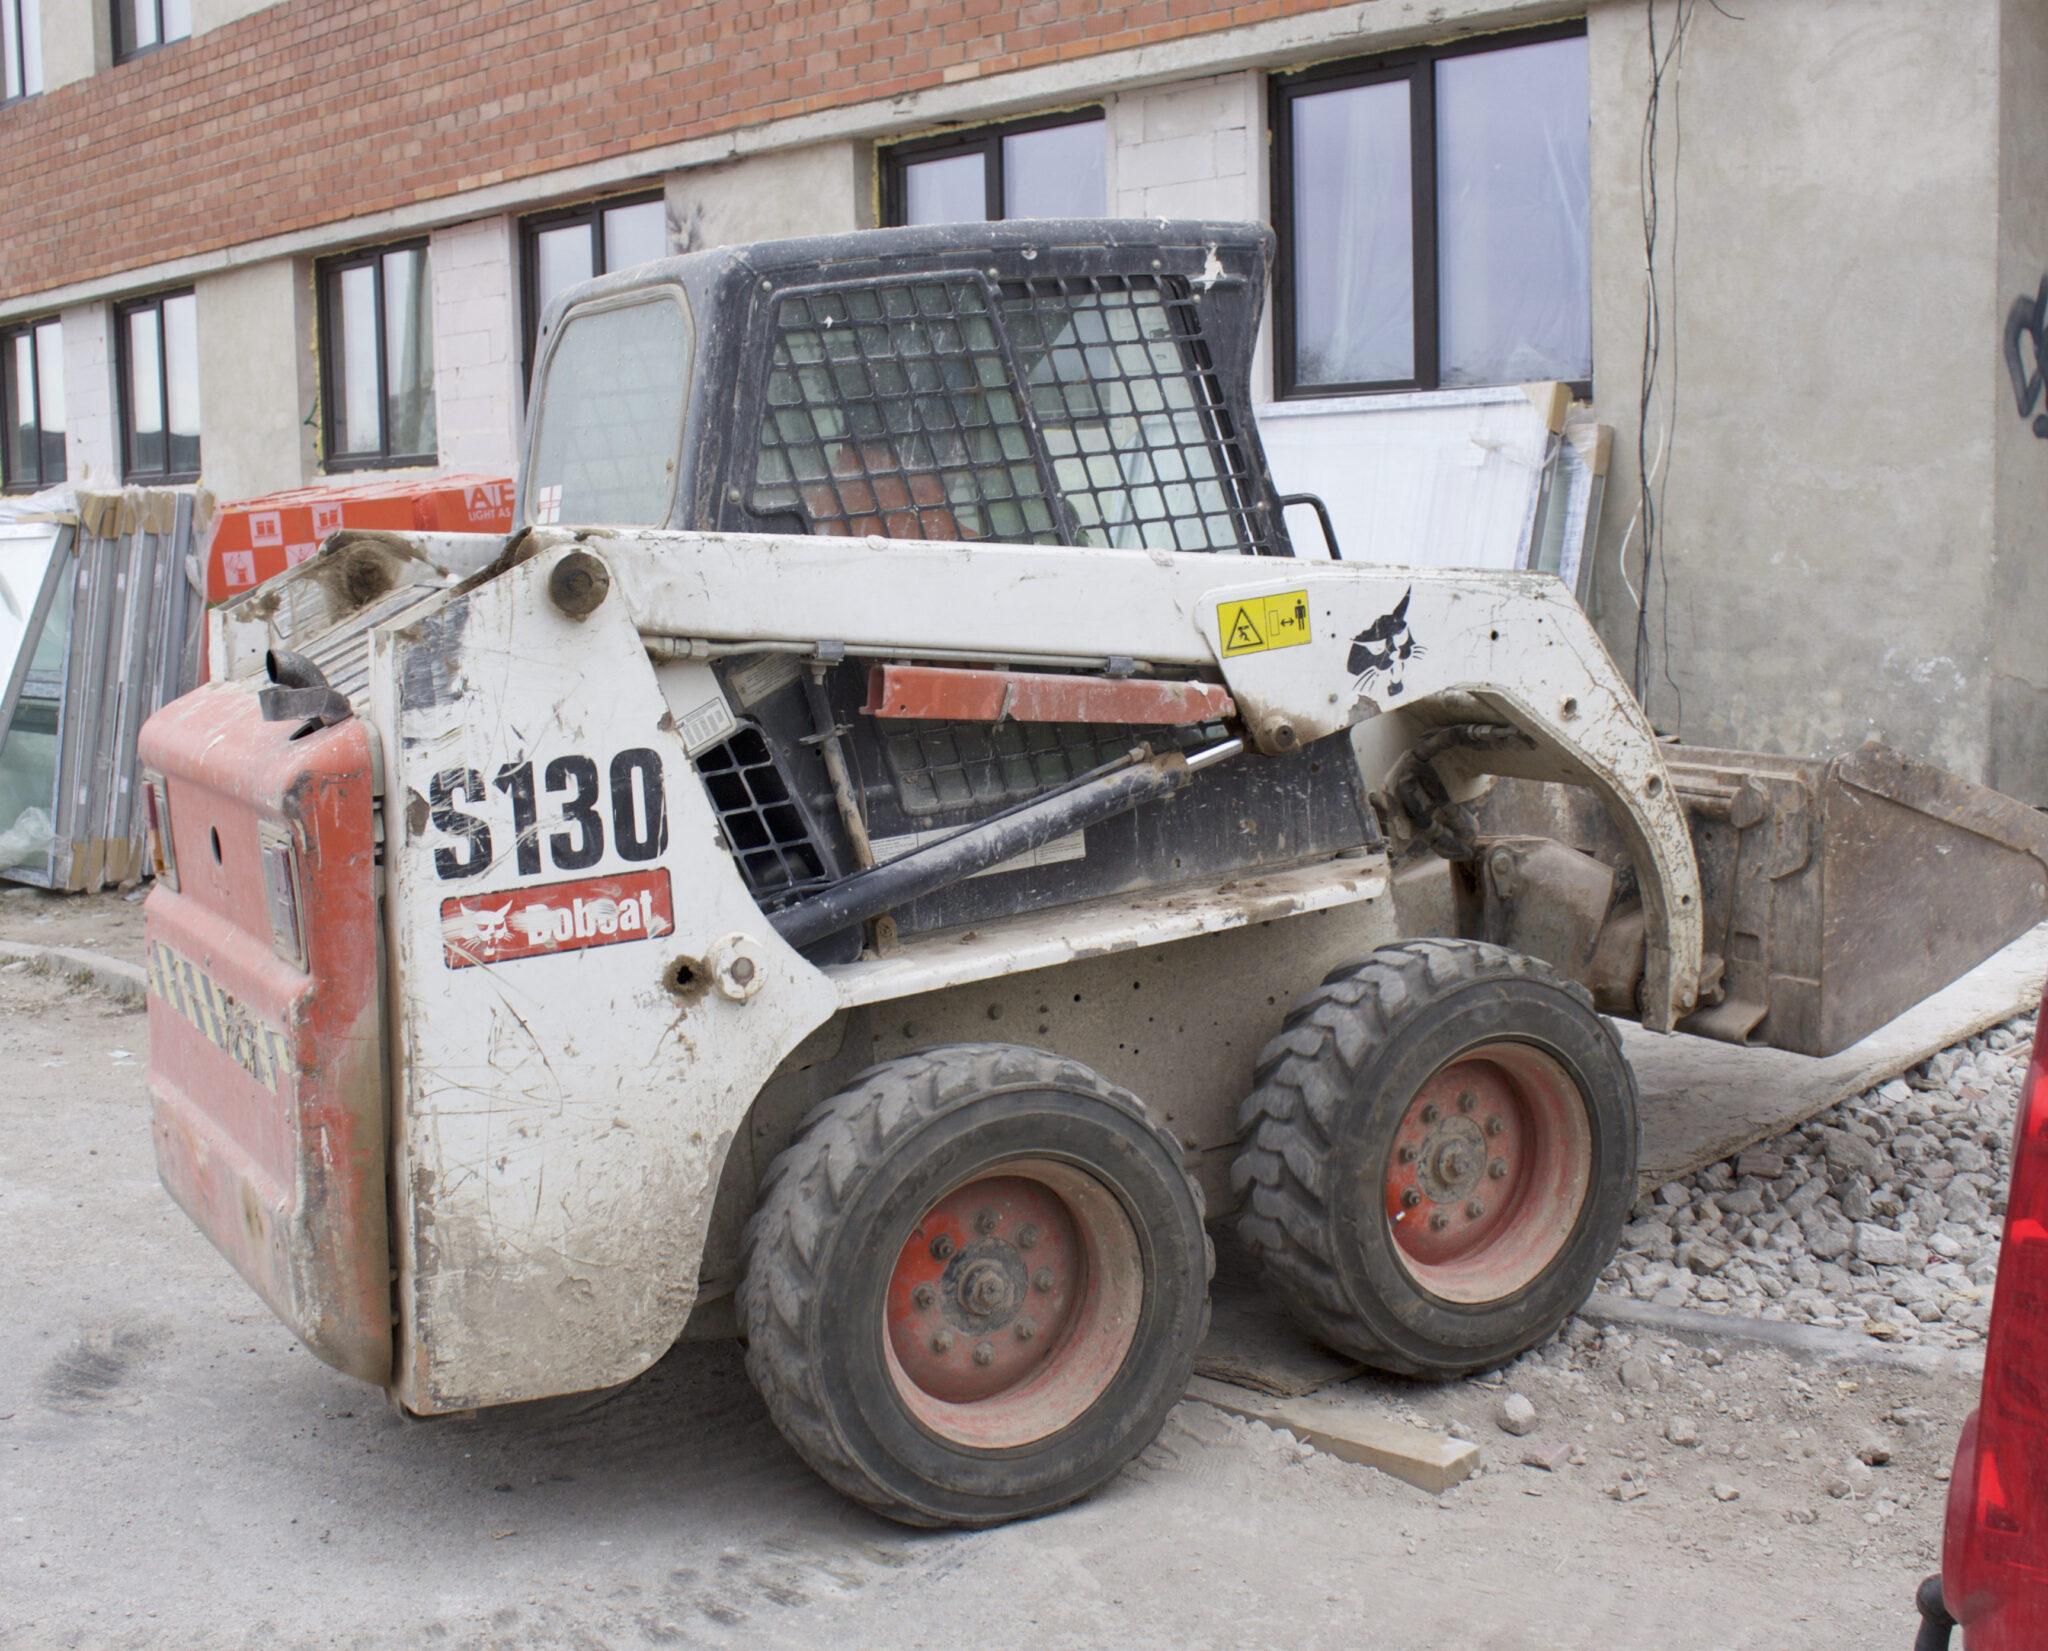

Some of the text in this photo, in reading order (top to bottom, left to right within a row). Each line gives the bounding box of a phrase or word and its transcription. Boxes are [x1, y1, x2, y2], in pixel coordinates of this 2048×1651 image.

[469, 507, 511, 521] LIGHT AS
[430, 748, 668, 880] S130
